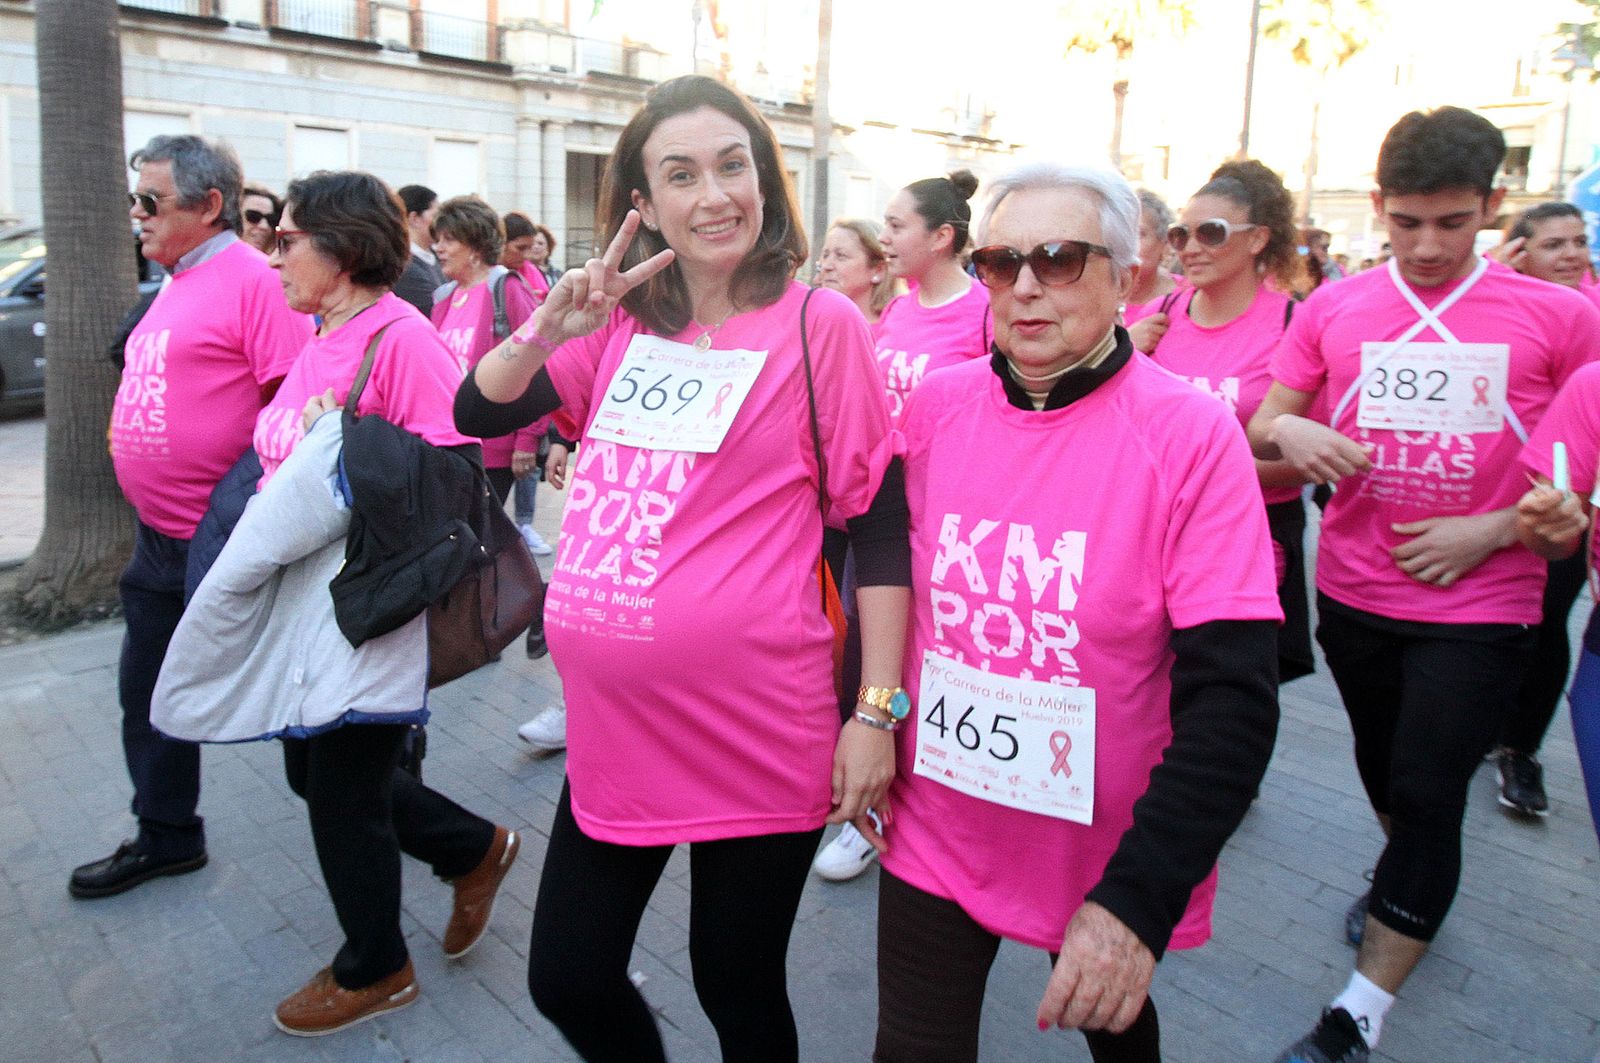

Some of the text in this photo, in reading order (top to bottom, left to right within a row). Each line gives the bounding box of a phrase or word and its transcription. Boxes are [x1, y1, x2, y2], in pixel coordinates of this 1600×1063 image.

[648, 348, 693, 368] Carrera
[696, 358, 711, 370] de
[611, 366, 703, 416] 569
[1368, 367, 1449, 402] 382
[1365, 443, 1476, 479] LLAS
[562, 477, 676, 545] POR
[930, 513, 1088, 611] KM
[574, 585, 590, 600] de
[593, 587, 606, 602] la
[611, 591, 656, 610] Mujer
[930, 588, 1081, 673] POR
[944, 670, 991, 698] Carrera
[995, 687, 1014, 703] de
[1019, 691, 1032, 706] la
[1038, 695, 1084, 714] Mujer
[924, 694, 1019, 761] 465
[1021, 708, 1083, 727] Huelva 2019
